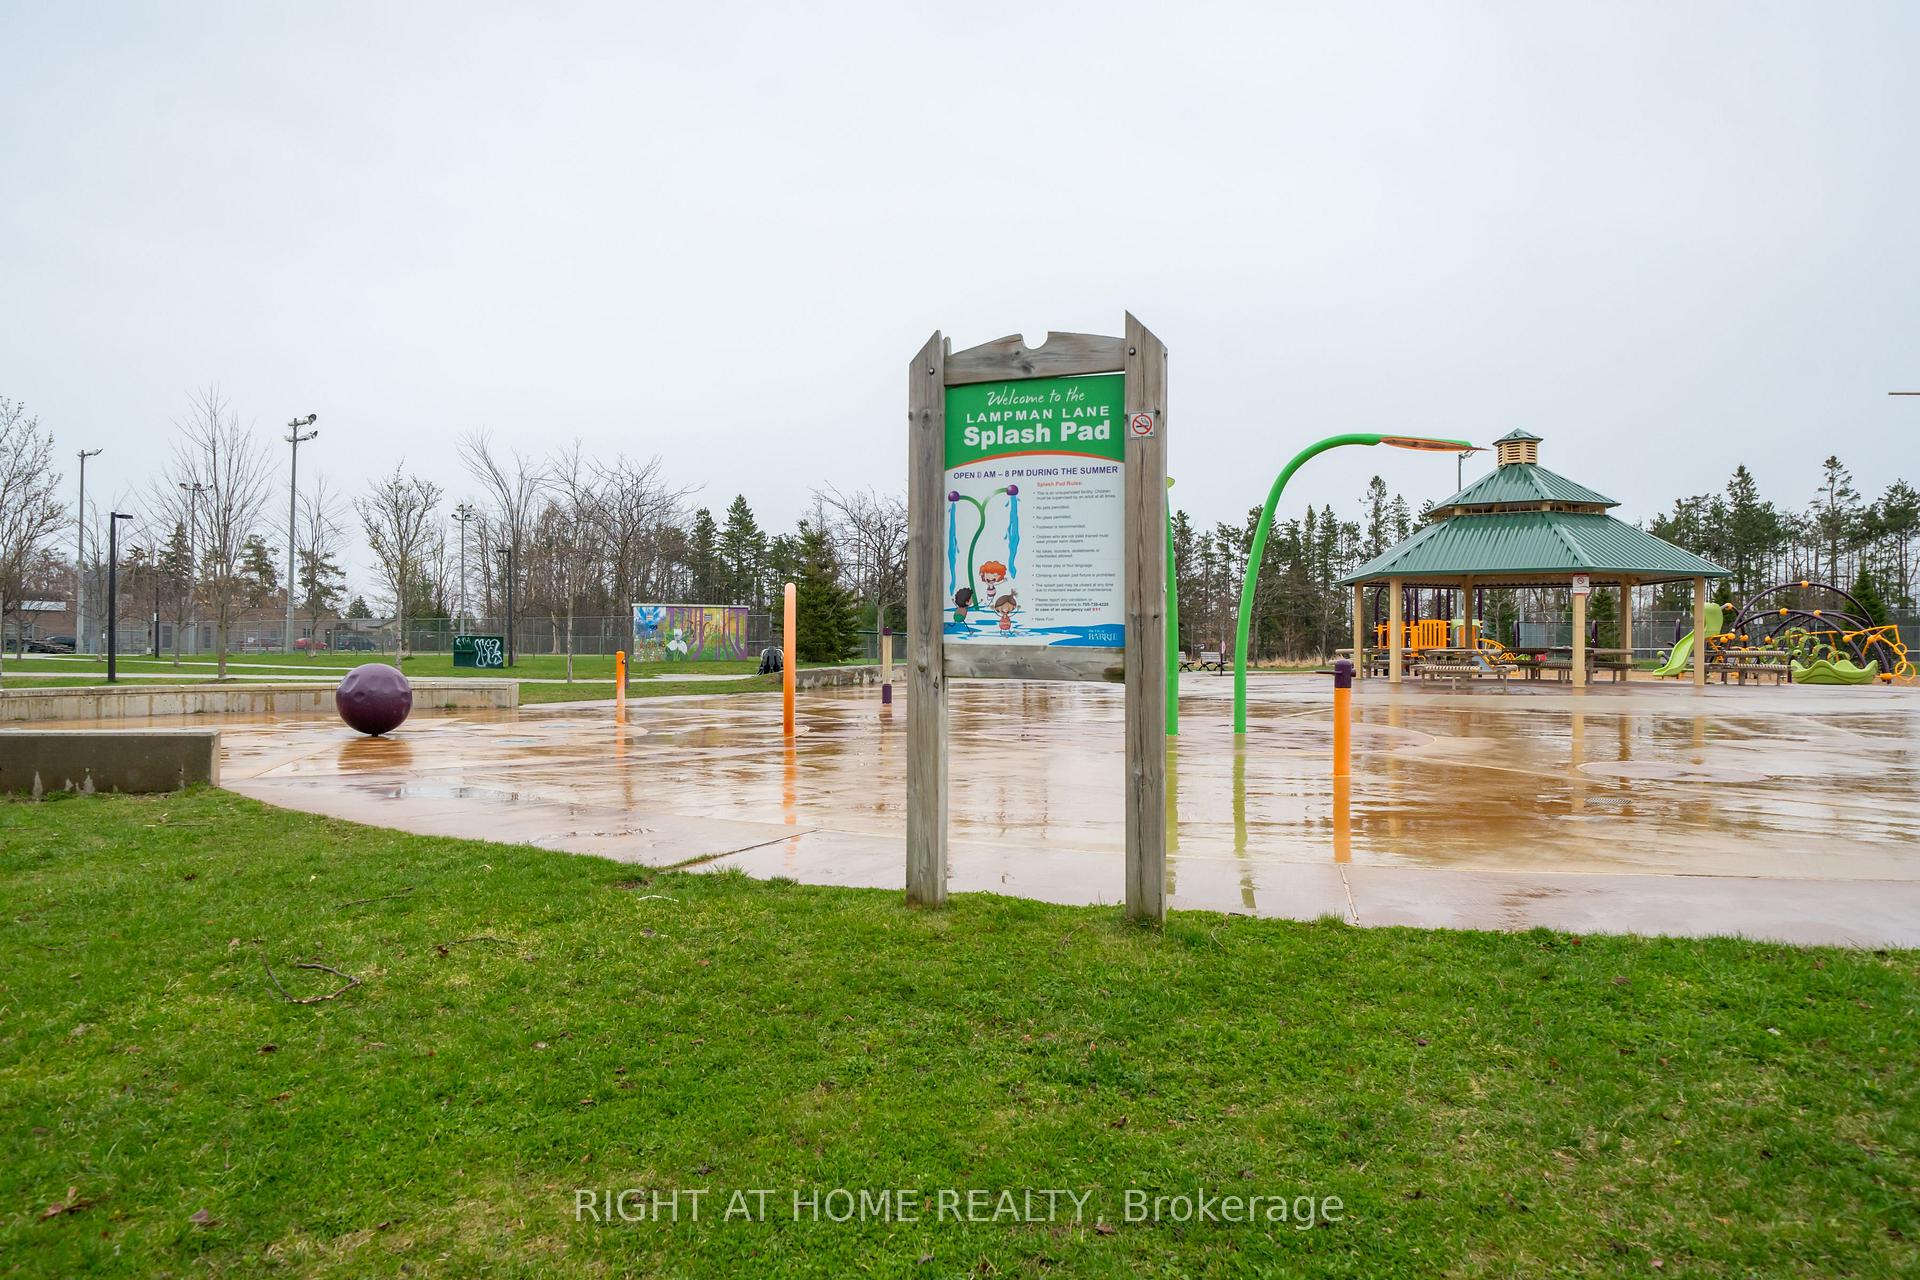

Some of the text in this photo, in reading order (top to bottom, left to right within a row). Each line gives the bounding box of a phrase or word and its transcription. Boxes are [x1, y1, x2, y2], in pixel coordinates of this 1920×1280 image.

[987, 385, 1086, 406] Welcome to the
[966, 405, 1110, 424] LAMPMAN LANE
[963, 420, 1110, 450] Splash Pad
[954, 472, 975, 480] OPEN
[984, 470, 996, 478] AM
[1012, 470, 1024, 478] PM
[1026, 468, 1058, 477] DURING
[1060, 467, 1078, 475] THE
[1080, 466, 1118, 475] SUMMER
